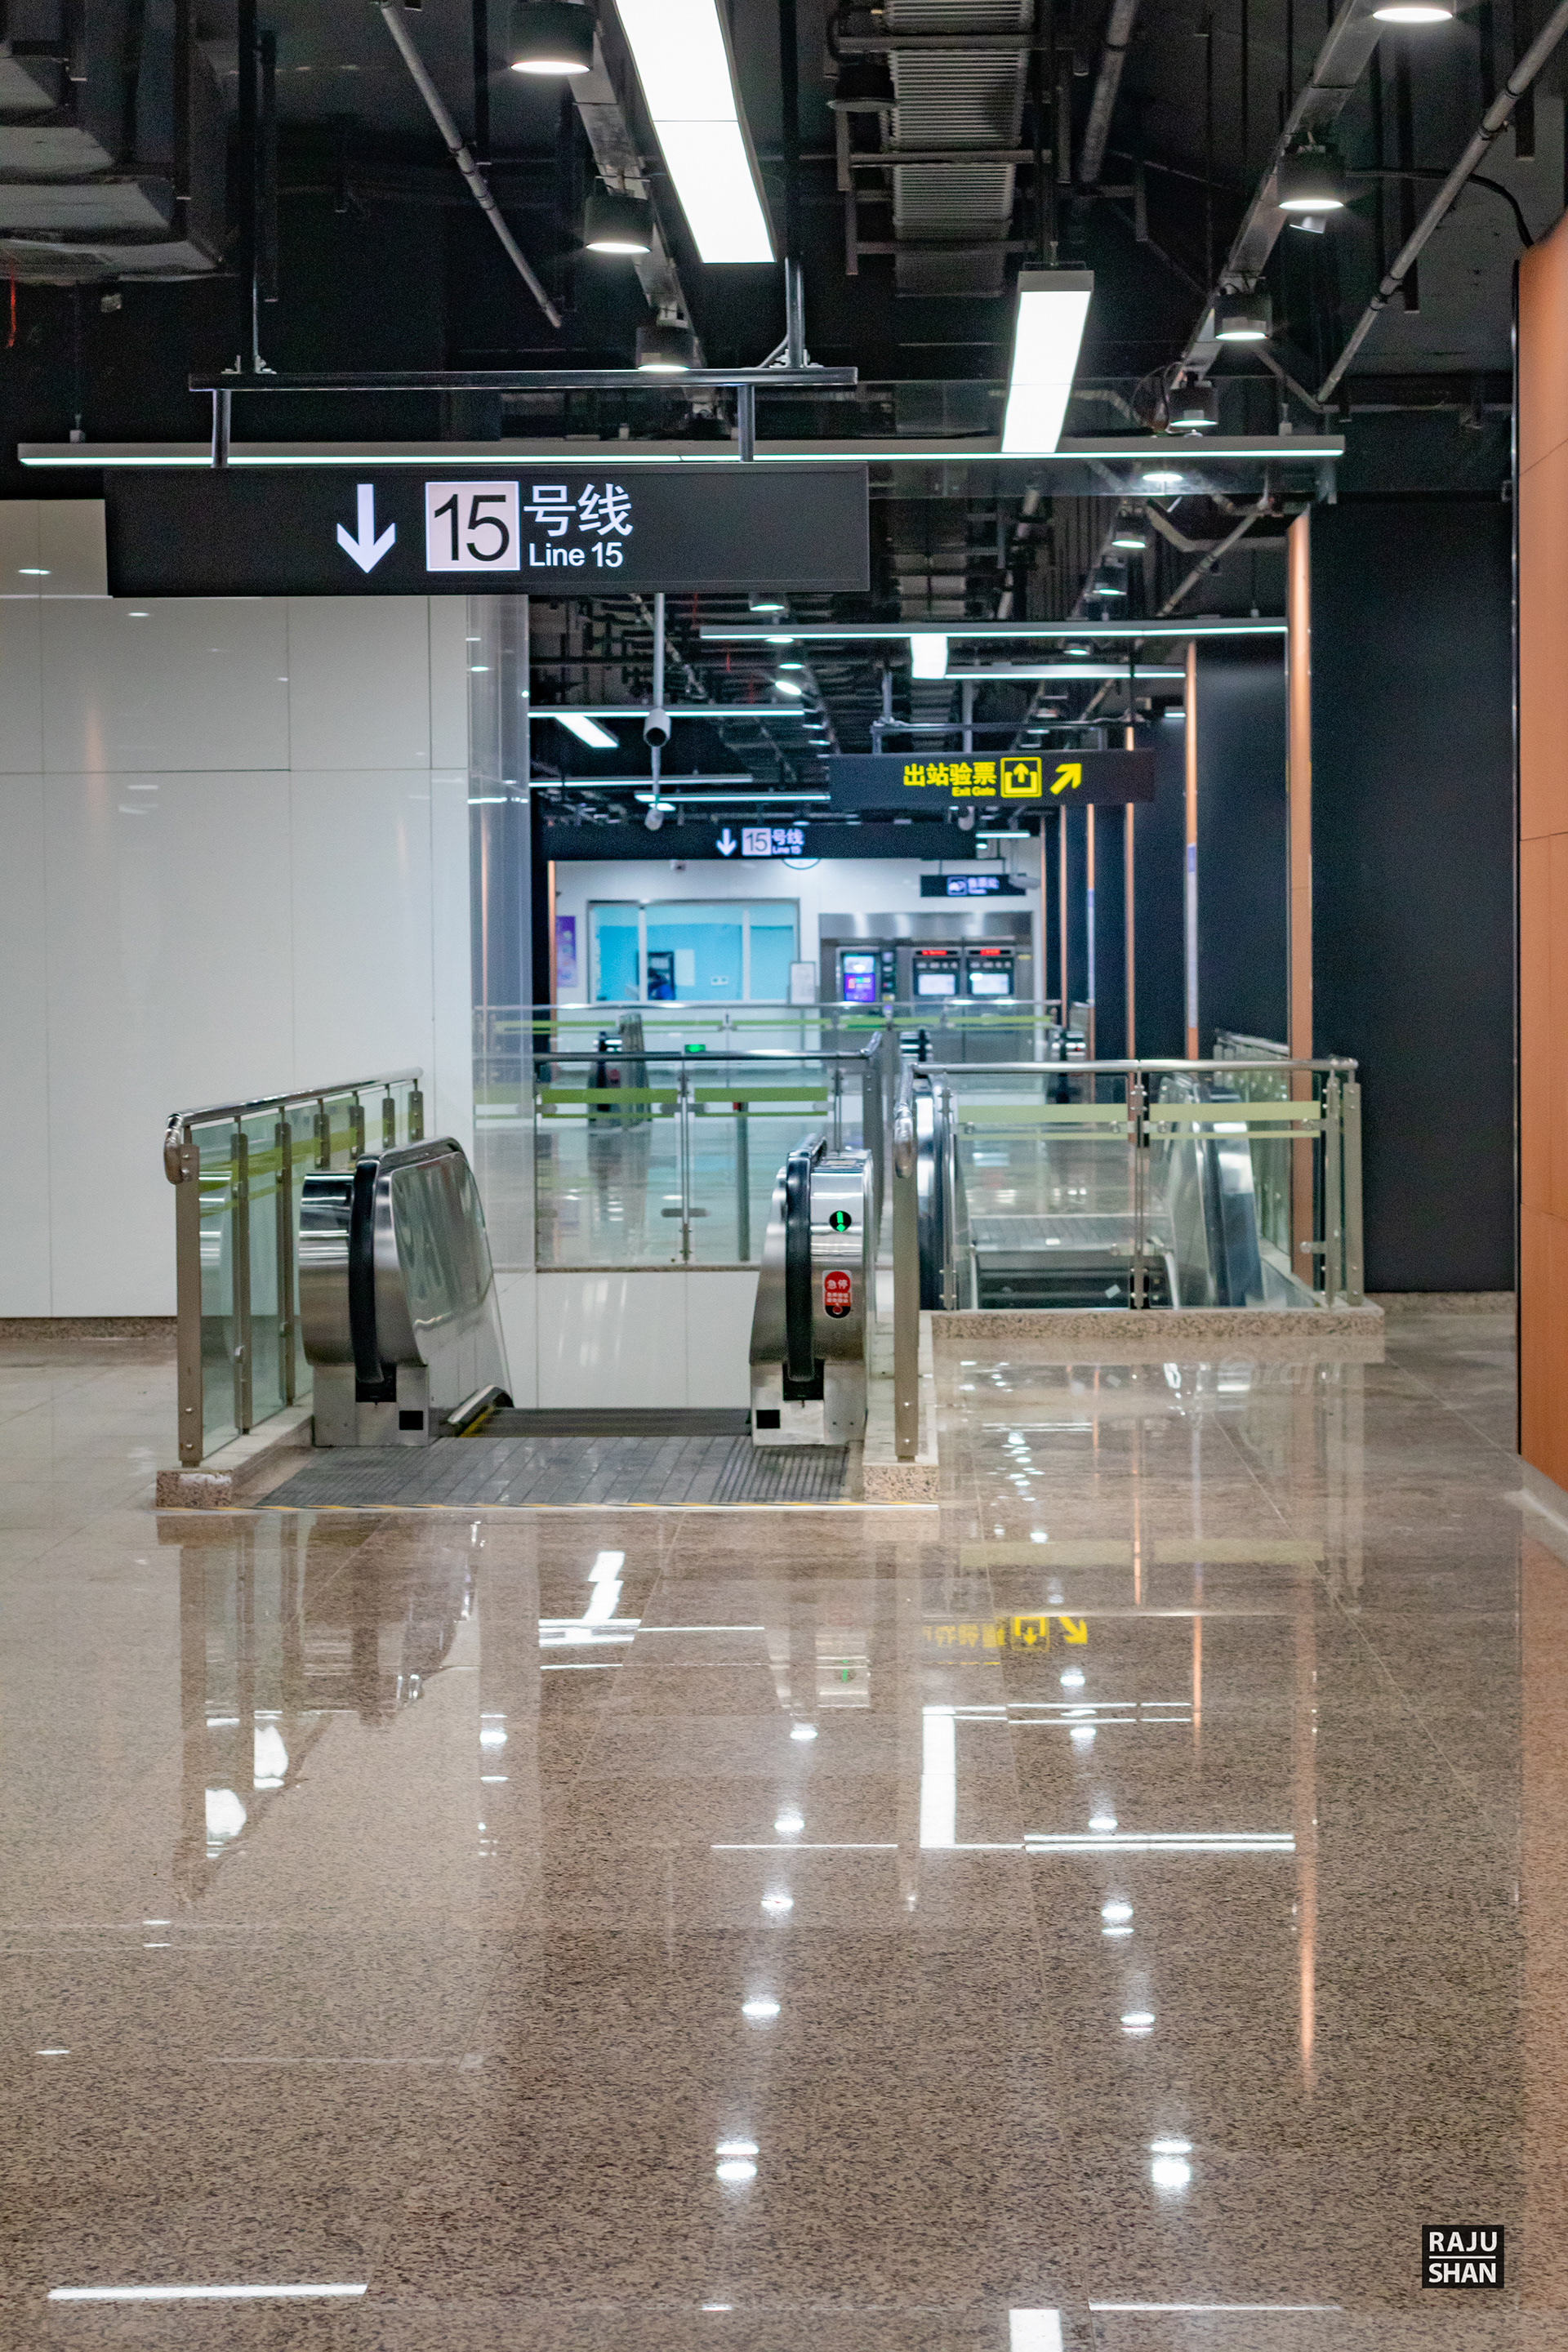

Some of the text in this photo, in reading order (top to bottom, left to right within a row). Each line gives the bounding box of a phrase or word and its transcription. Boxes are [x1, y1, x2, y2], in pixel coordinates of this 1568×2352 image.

[434, 483, 634, 561] 15 号线
[529, 541, 624, 568] Line 15
[903, 762, 997, 786] 出站验票
